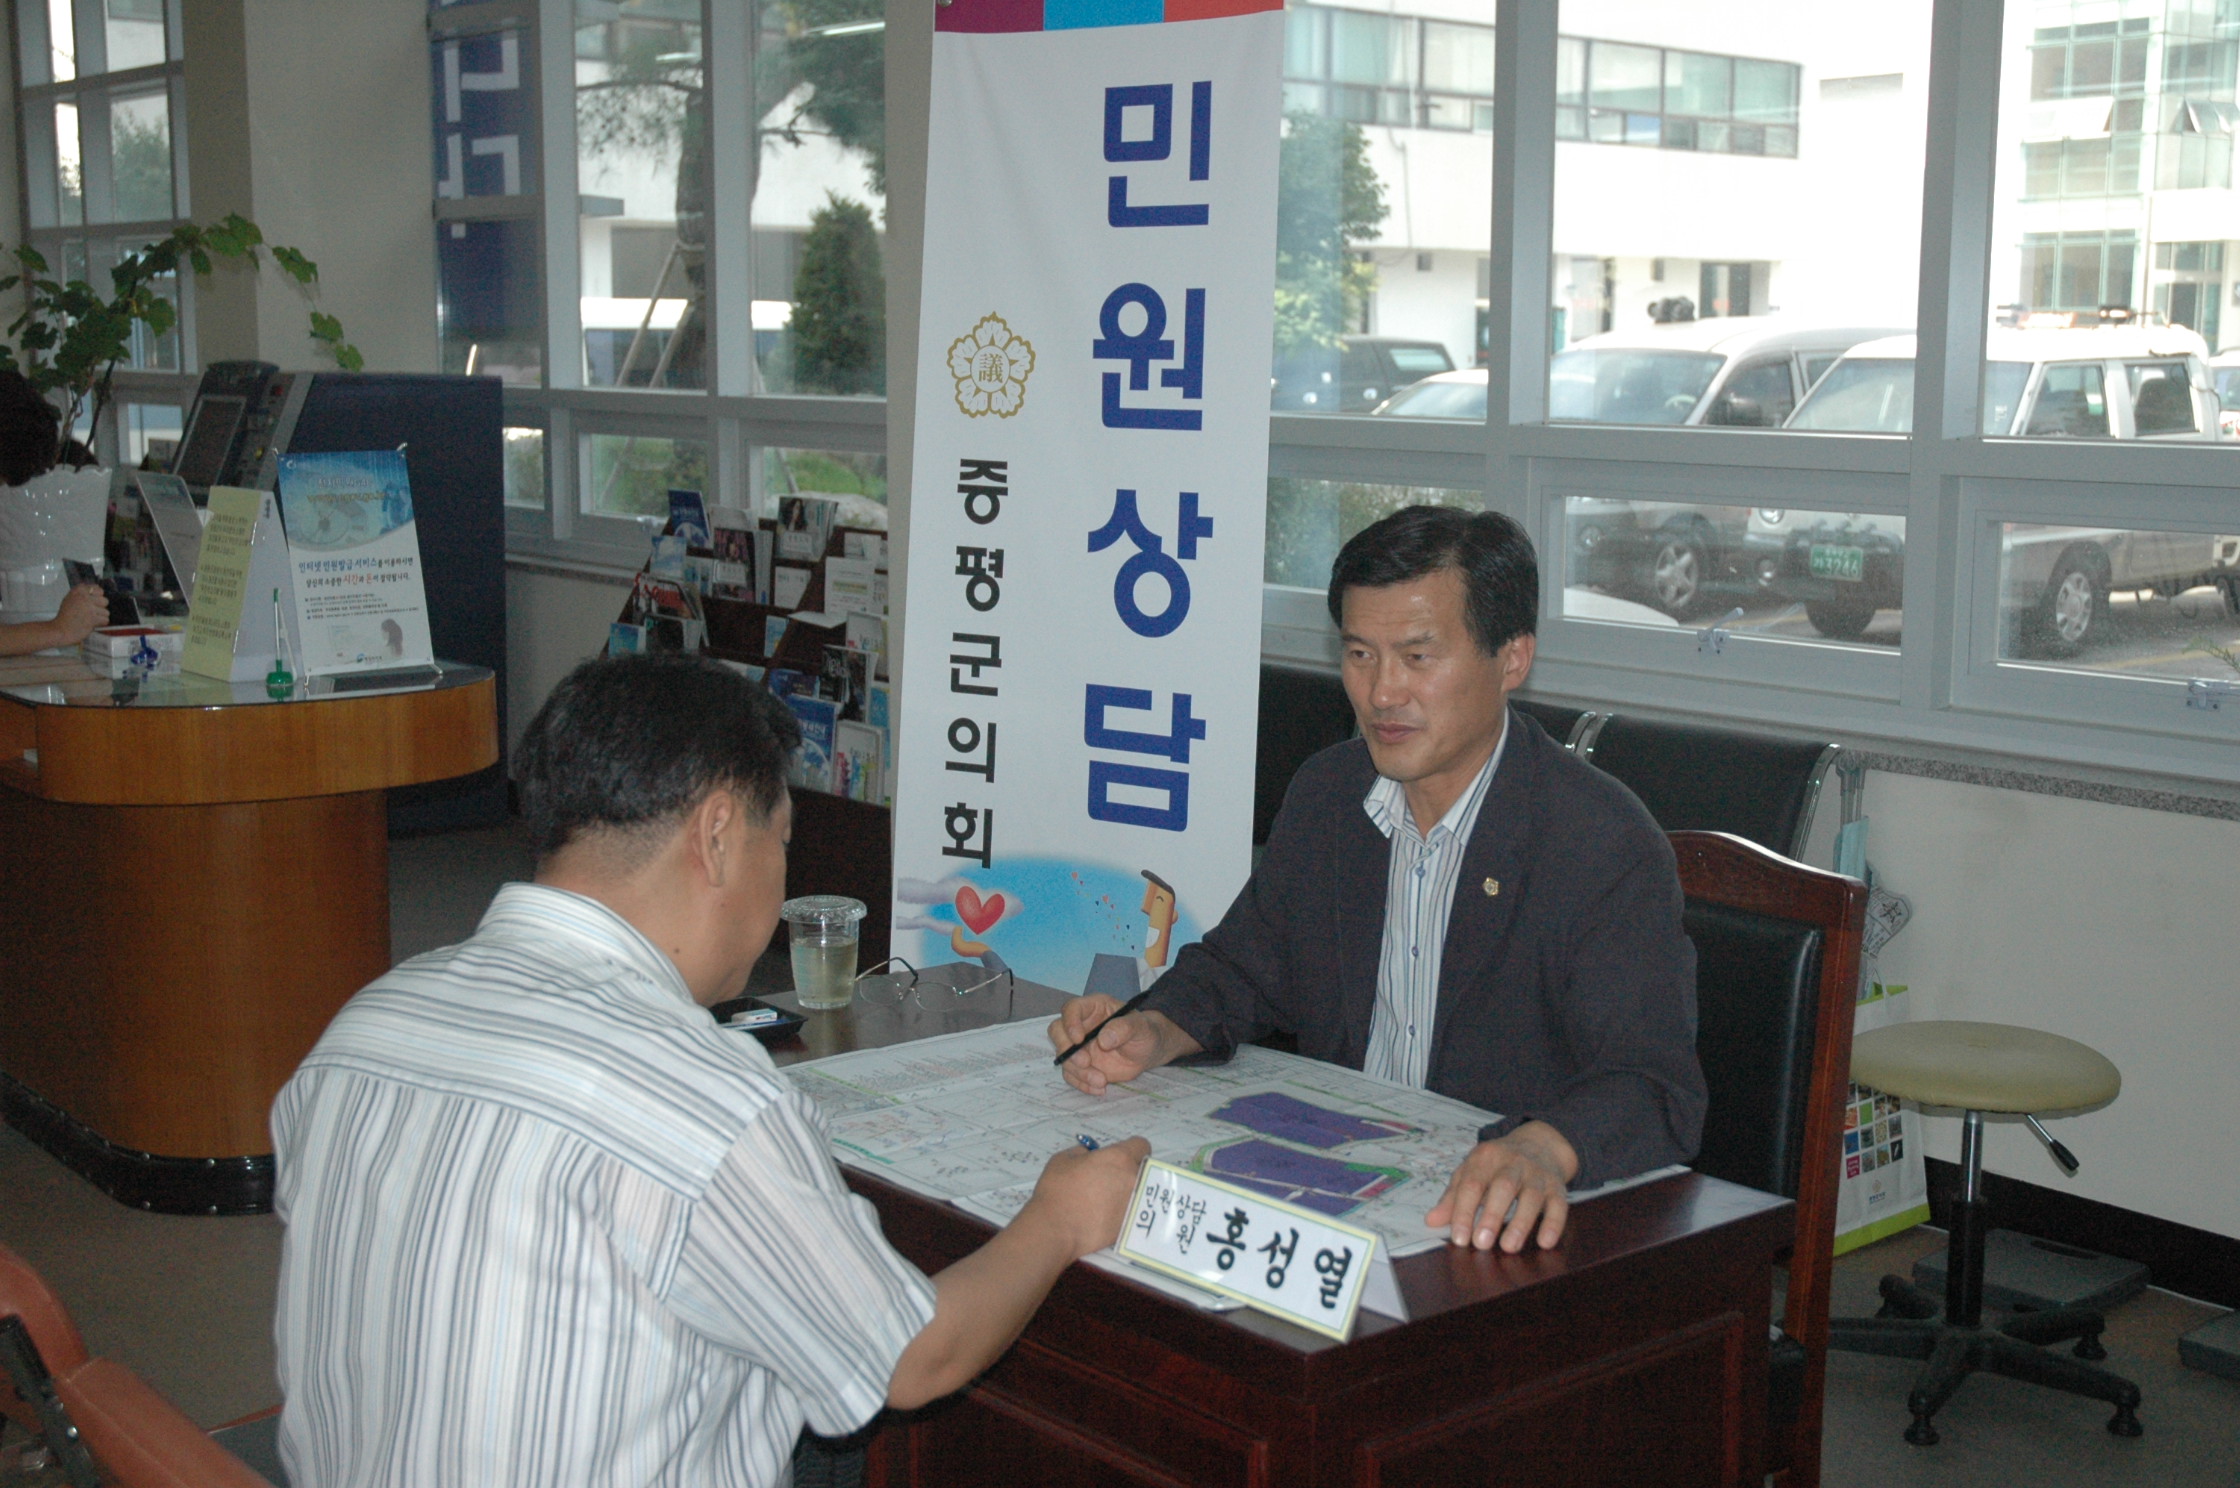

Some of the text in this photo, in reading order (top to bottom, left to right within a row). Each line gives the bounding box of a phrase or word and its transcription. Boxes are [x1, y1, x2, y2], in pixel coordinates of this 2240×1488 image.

[1084, 81, 1213, 832] 민원상담
[942, 458, 1008, 869] 증평군의회
[1206, 1207, 1352, 1309] 홍성열
